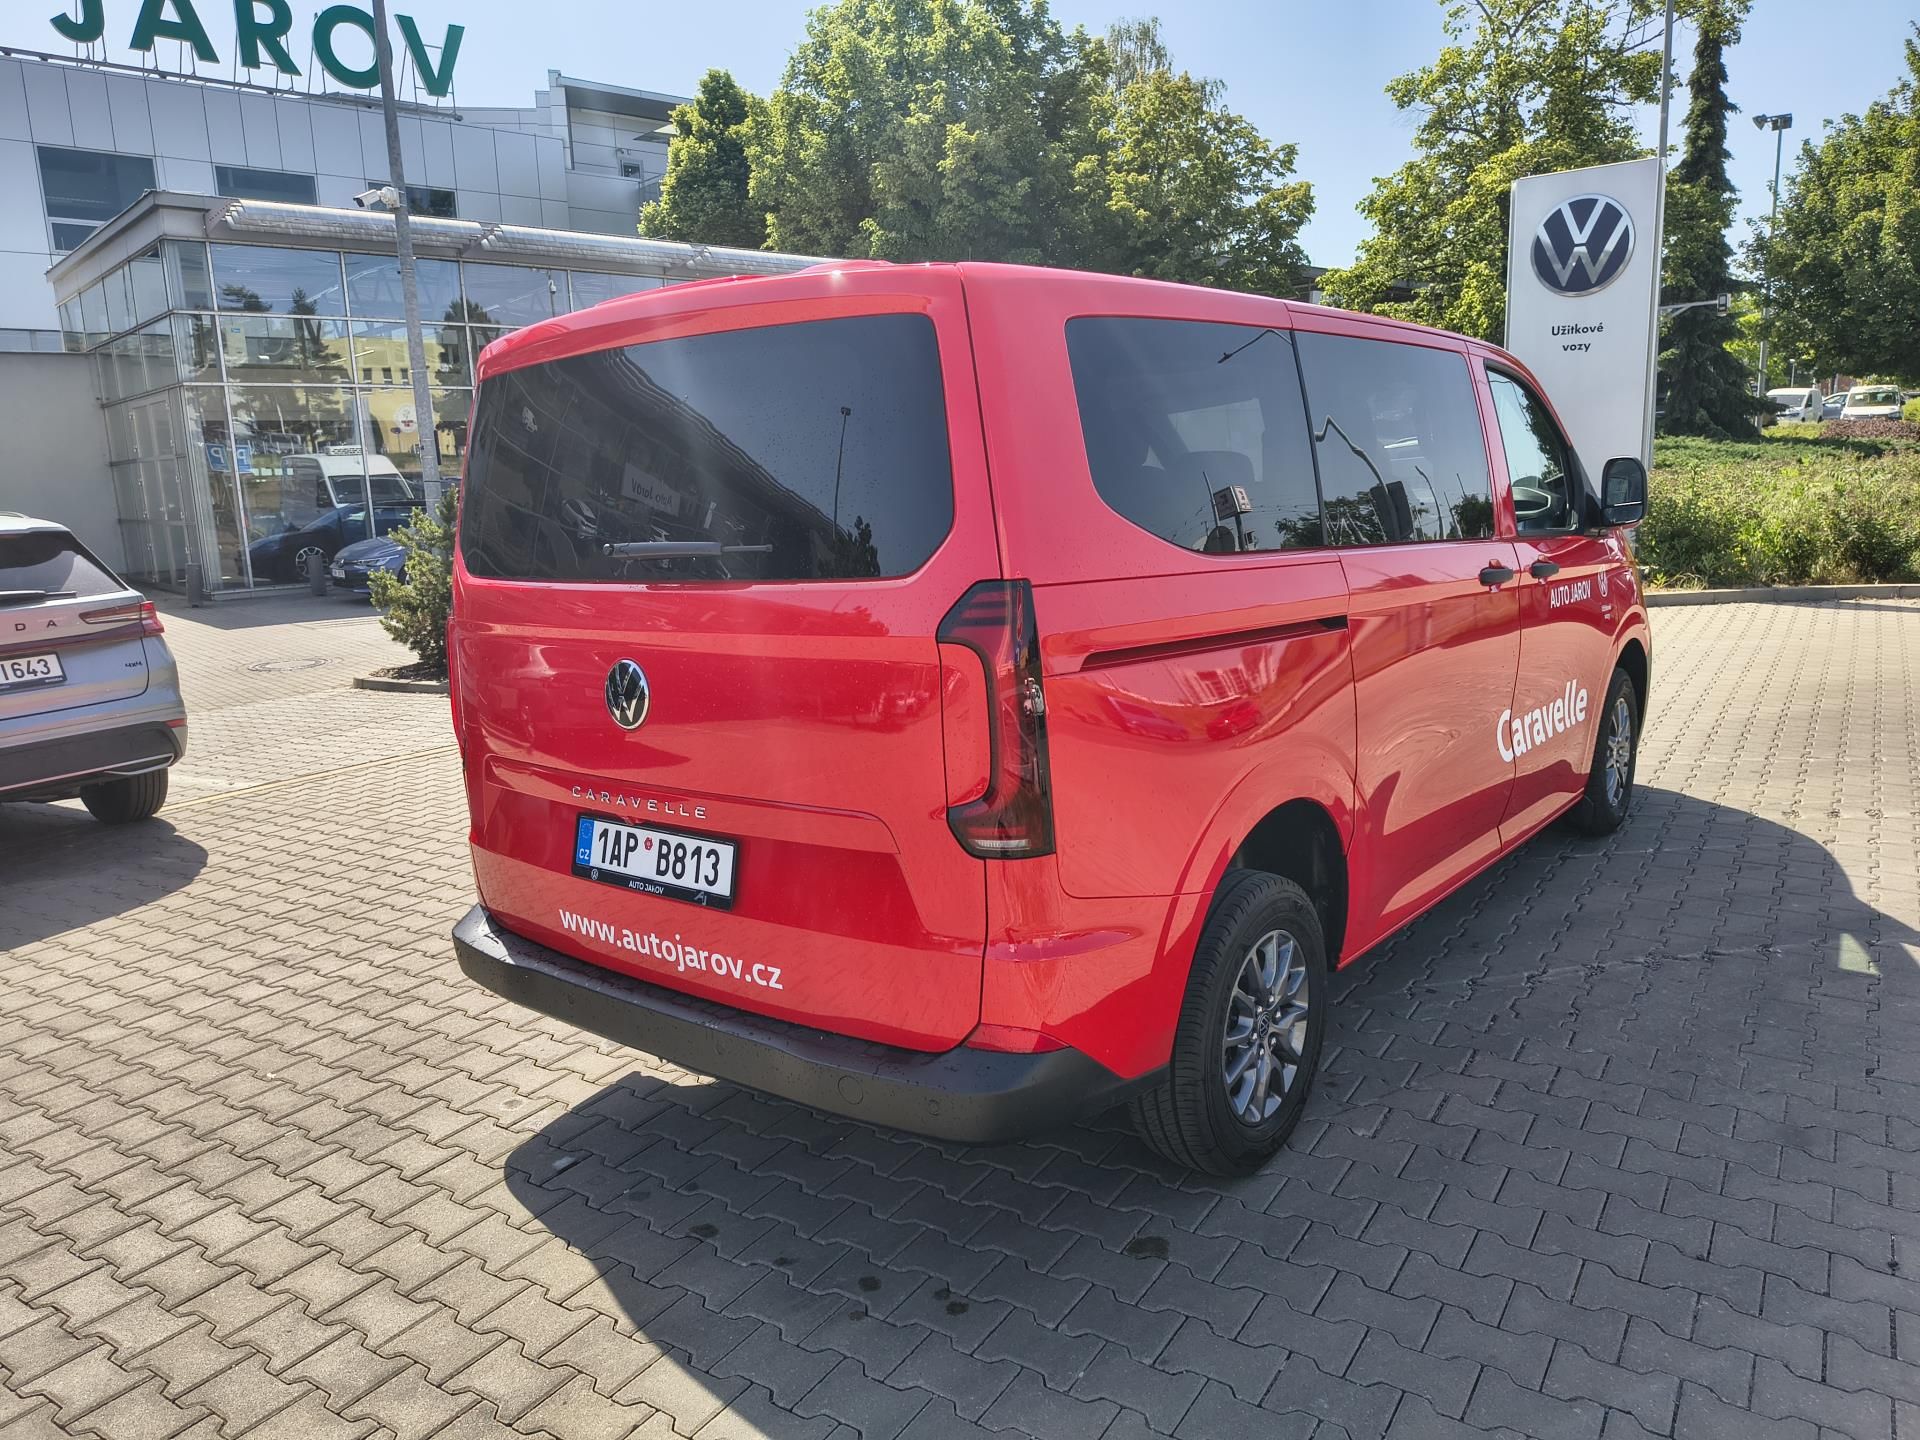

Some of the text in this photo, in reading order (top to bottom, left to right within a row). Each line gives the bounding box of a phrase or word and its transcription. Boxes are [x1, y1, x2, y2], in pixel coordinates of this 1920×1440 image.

[1551, 321, 1604, 336] Užitkové
[1562, 342, 1592, 353] vozy
[1550, 579, 1591, 609] AUTO JAROV
[1496, 679, 1588, 763] Caravelle
[572, 786, 707, 819] CARAVELLE
[579, 848, 590, 860] CZ
[598, 827, 720, 887] 1AP B813
[628, 880, 665, 895] AUTO JAROV
[559, 908, 784, 989] www.autojarov.cz
